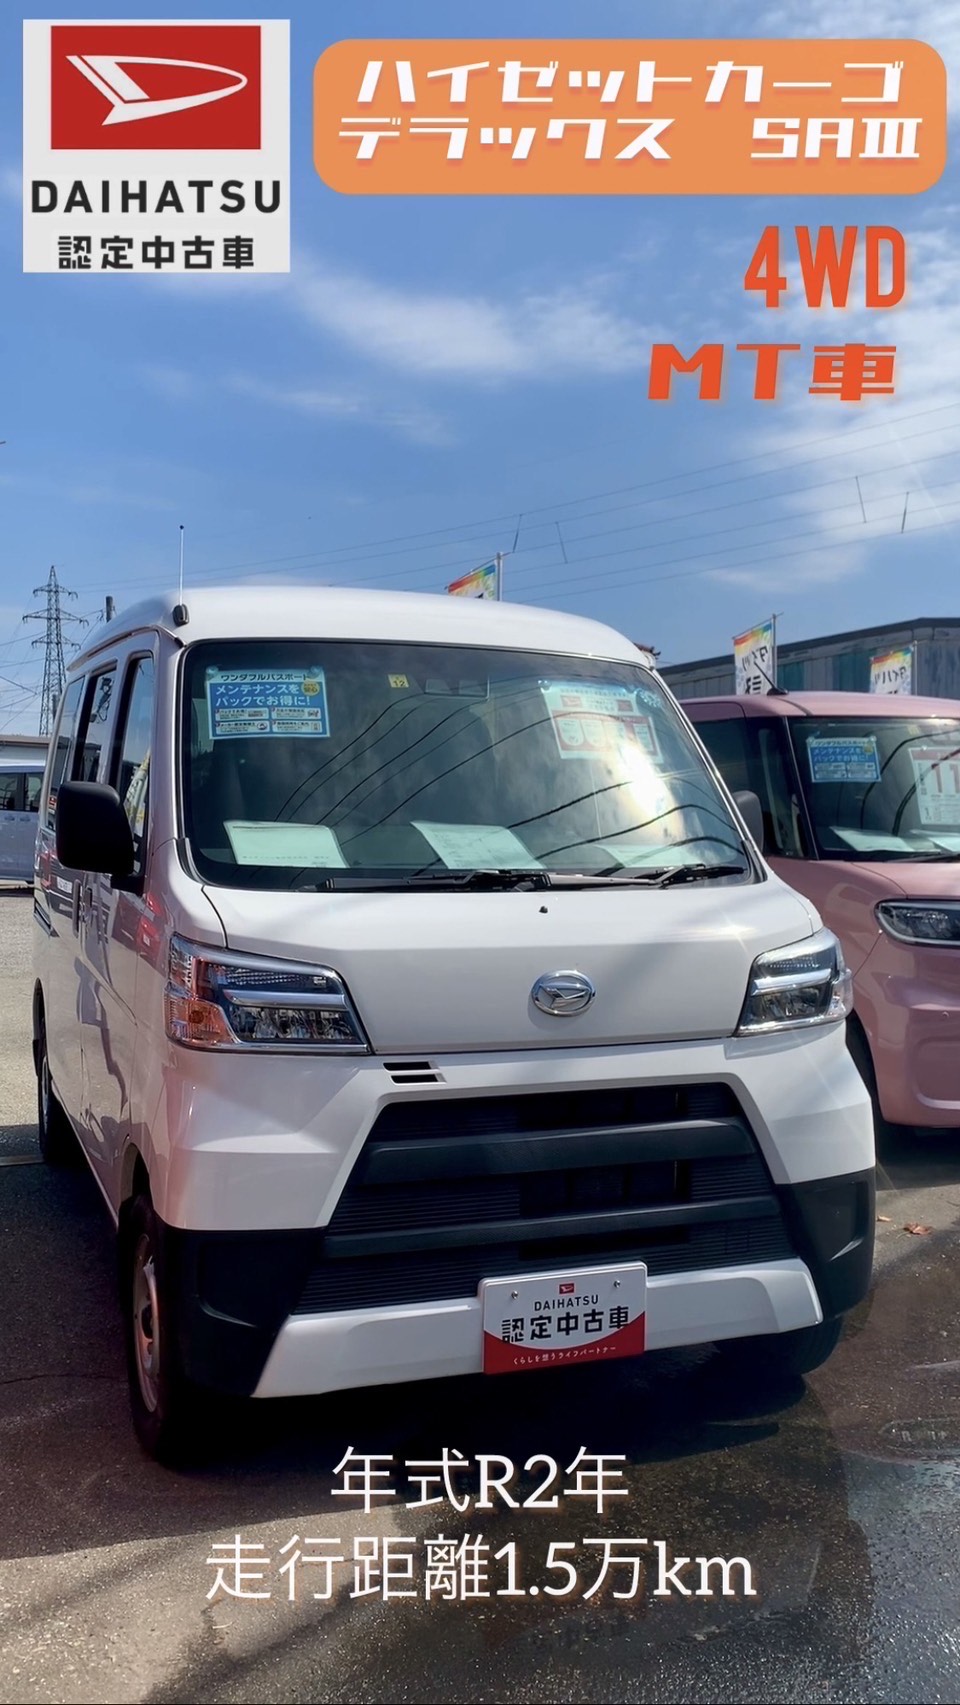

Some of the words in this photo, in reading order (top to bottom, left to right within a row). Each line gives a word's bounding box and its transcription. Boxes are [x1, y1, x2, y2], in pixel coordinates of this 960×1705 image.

[215, 683, 300, 695] メンテナンスを
[533, 1294, 600, 1313] DAIHATSU
[501, 1305, 629, 1344] 認定中古車
